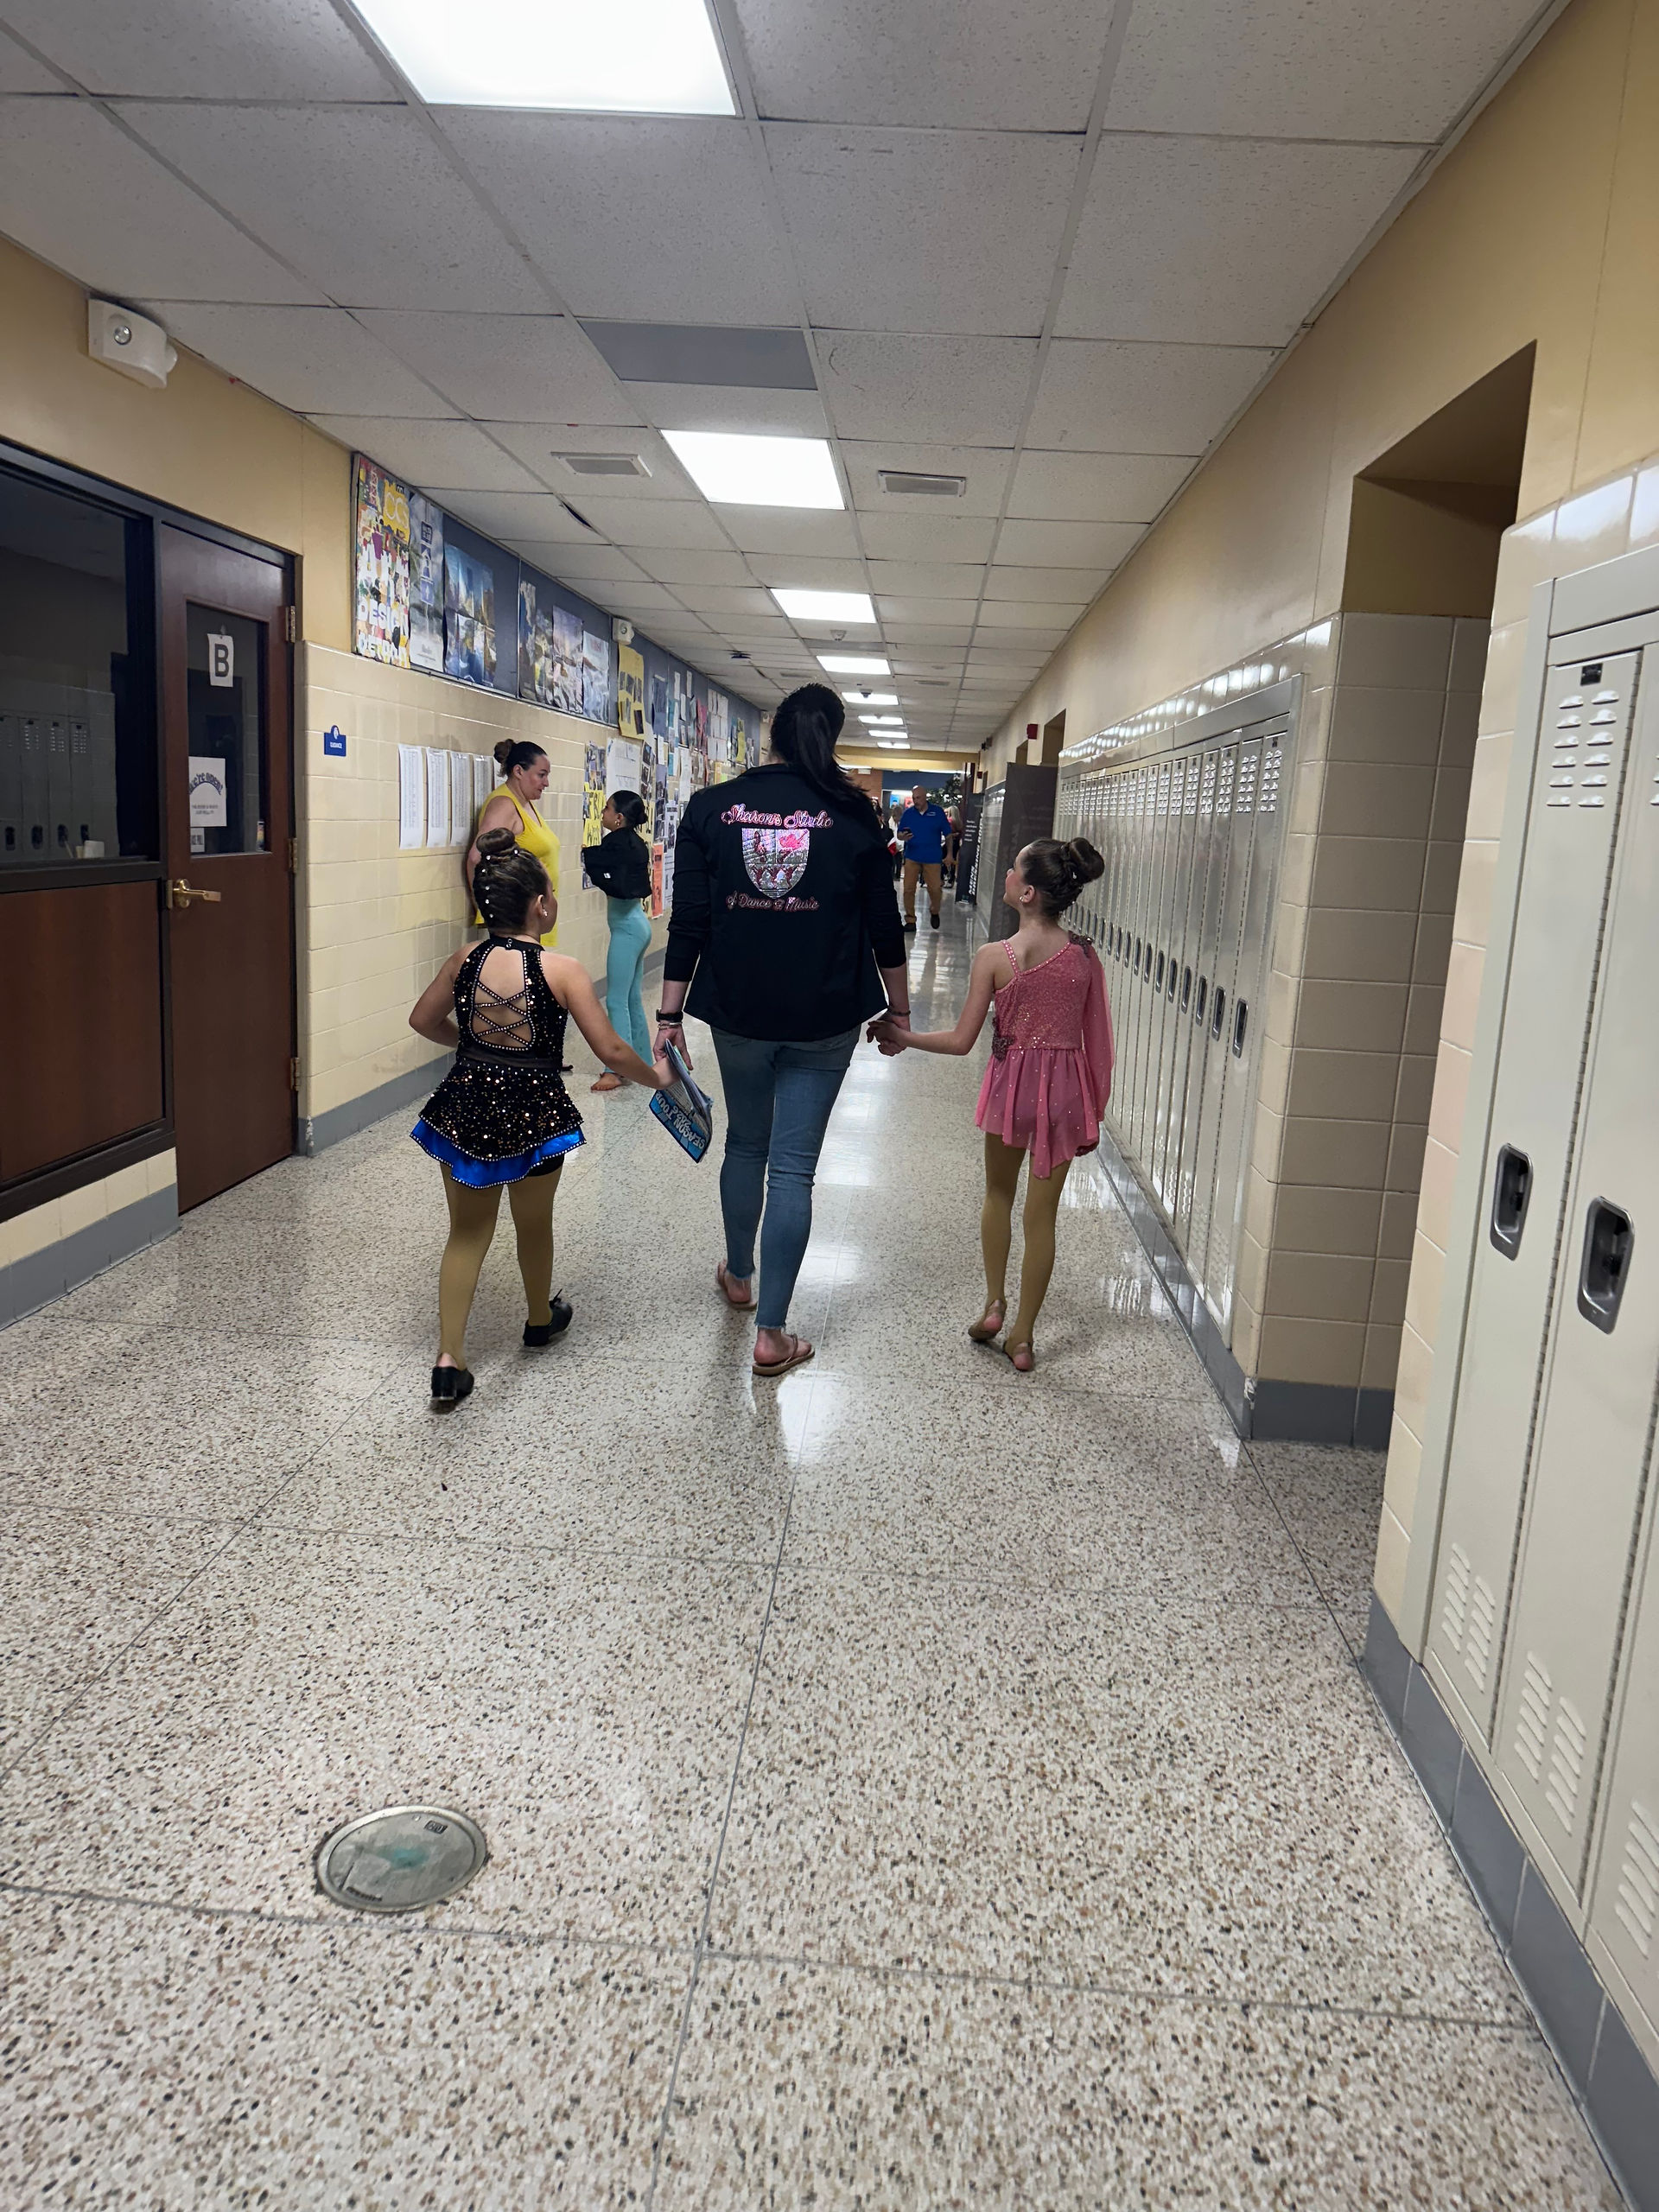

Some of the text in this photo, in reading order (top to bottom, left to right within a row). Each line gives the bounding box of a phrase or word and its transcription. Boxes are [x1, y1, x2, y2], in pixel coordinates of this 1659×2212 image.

[214, 643, 229, 677] B
[784, 810, 833, 829] Studio
[727, 890, 738, 910] of
[739, 893, 772, 908] Dance
[785, 896, 820, 912] Music
[674, 1118, 706, 1149] SEASON
